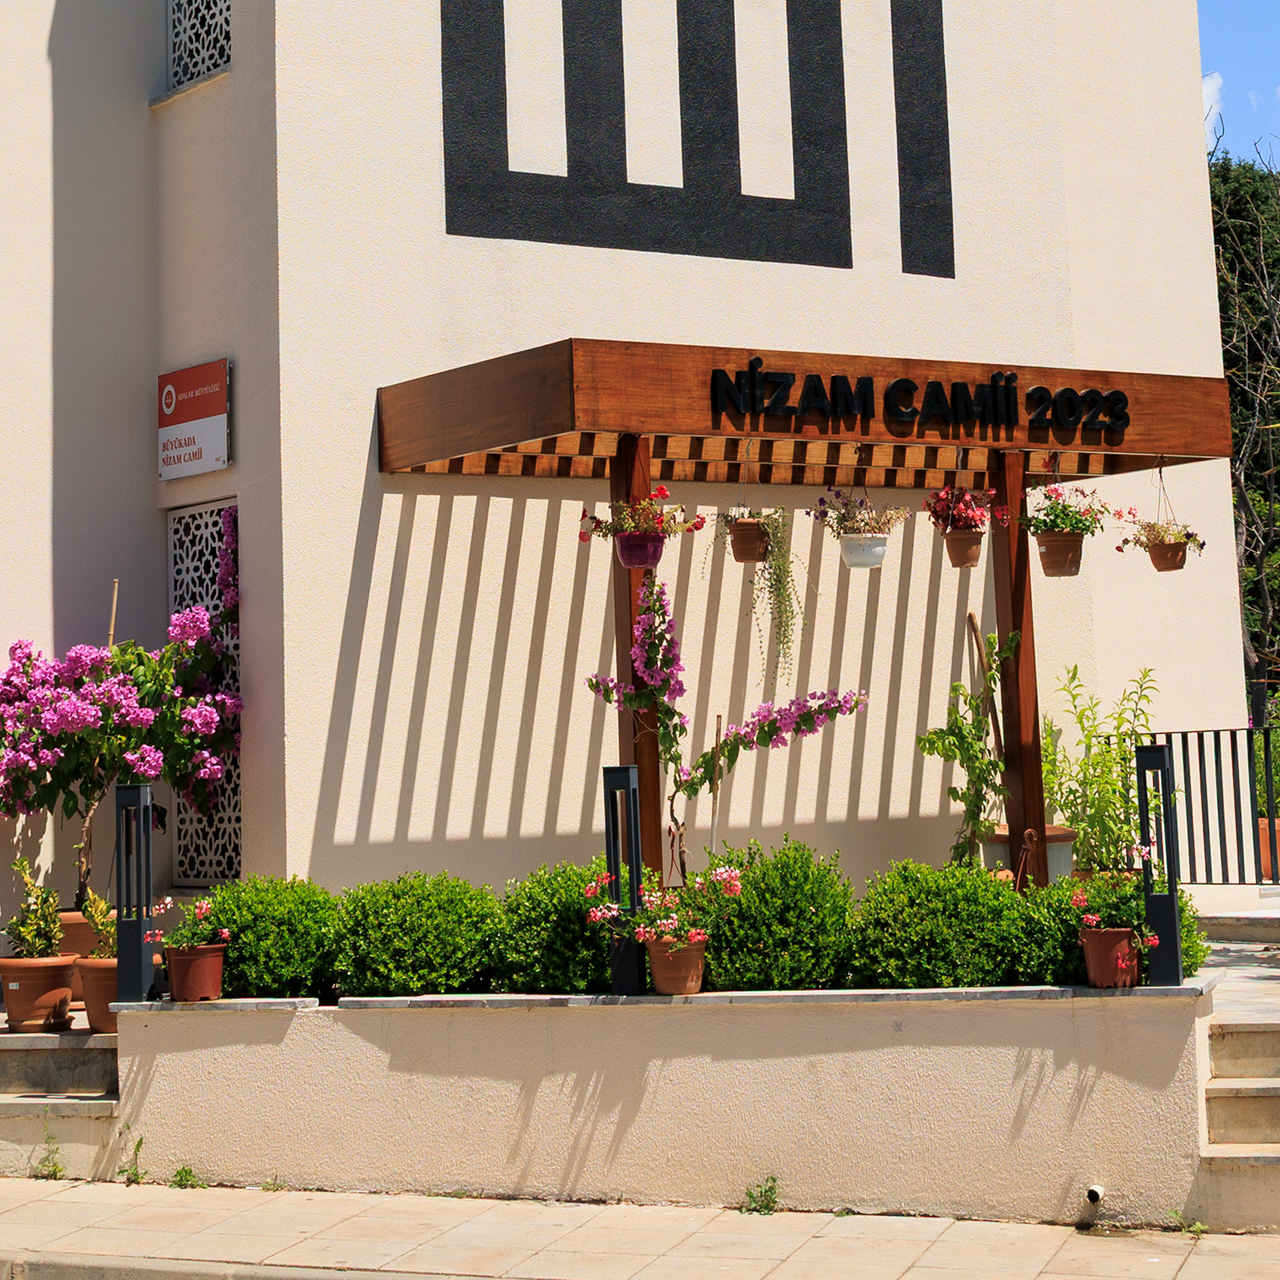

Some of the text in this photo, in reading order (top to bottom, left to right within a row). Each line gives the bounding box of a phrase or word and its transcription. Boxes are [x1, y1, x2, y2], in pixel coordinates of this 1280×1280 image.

[710, 355, 875, 419] NİZAM
[1024, 385, 1131, 431] 2023
[162, 436, 196, 452] BÜYÜKADA
[162, 454, 182, 468] NİZAM
[183, 446, 203, 463] CAMİİ
